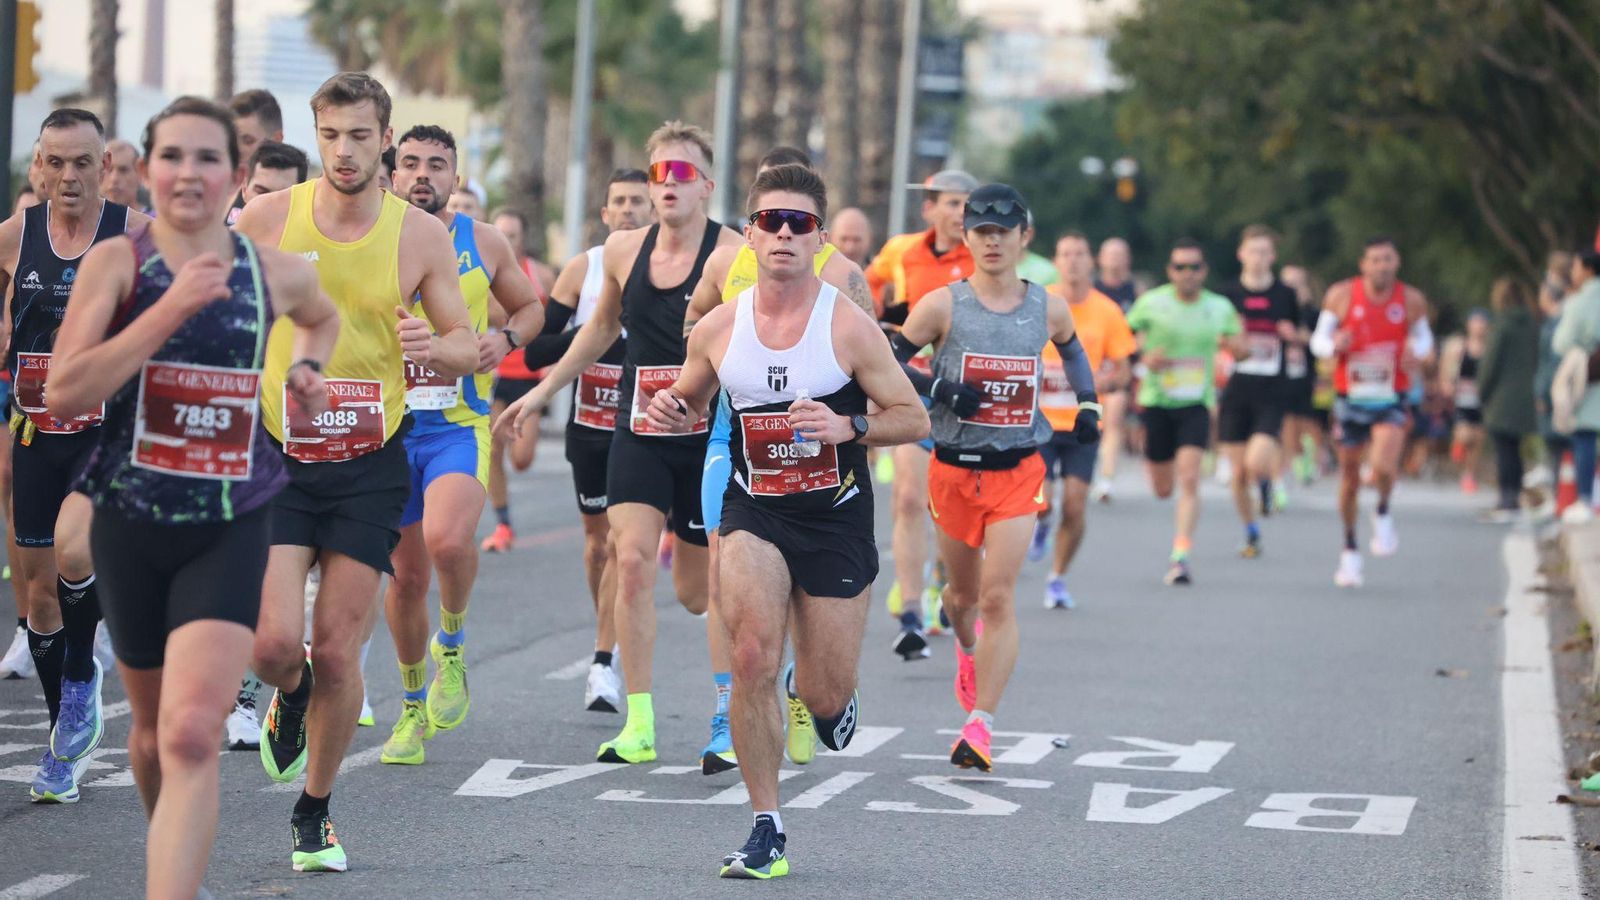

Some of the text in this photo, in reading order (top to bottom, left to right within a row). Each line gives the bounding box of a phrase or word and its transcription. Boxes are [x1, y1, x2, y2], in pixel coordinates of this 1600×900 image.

[767, 366, 788, 375] SCUF
[985, 358, 1032, 371] GENERALI
[595, 369, 622, 380] GENE
[653, 370, 682, 381] GENE
[326, 383, 375, 397] NERALI
[594, 386, 622, 402] 173
[981, 381, 1019, 397] 7577
[173, 403, 232, 430] 7883
[311, 410, 358, 427] 3088
[781, 458, 799, 466] RÉMY
[453, 758, 1418, 836] BASICA
